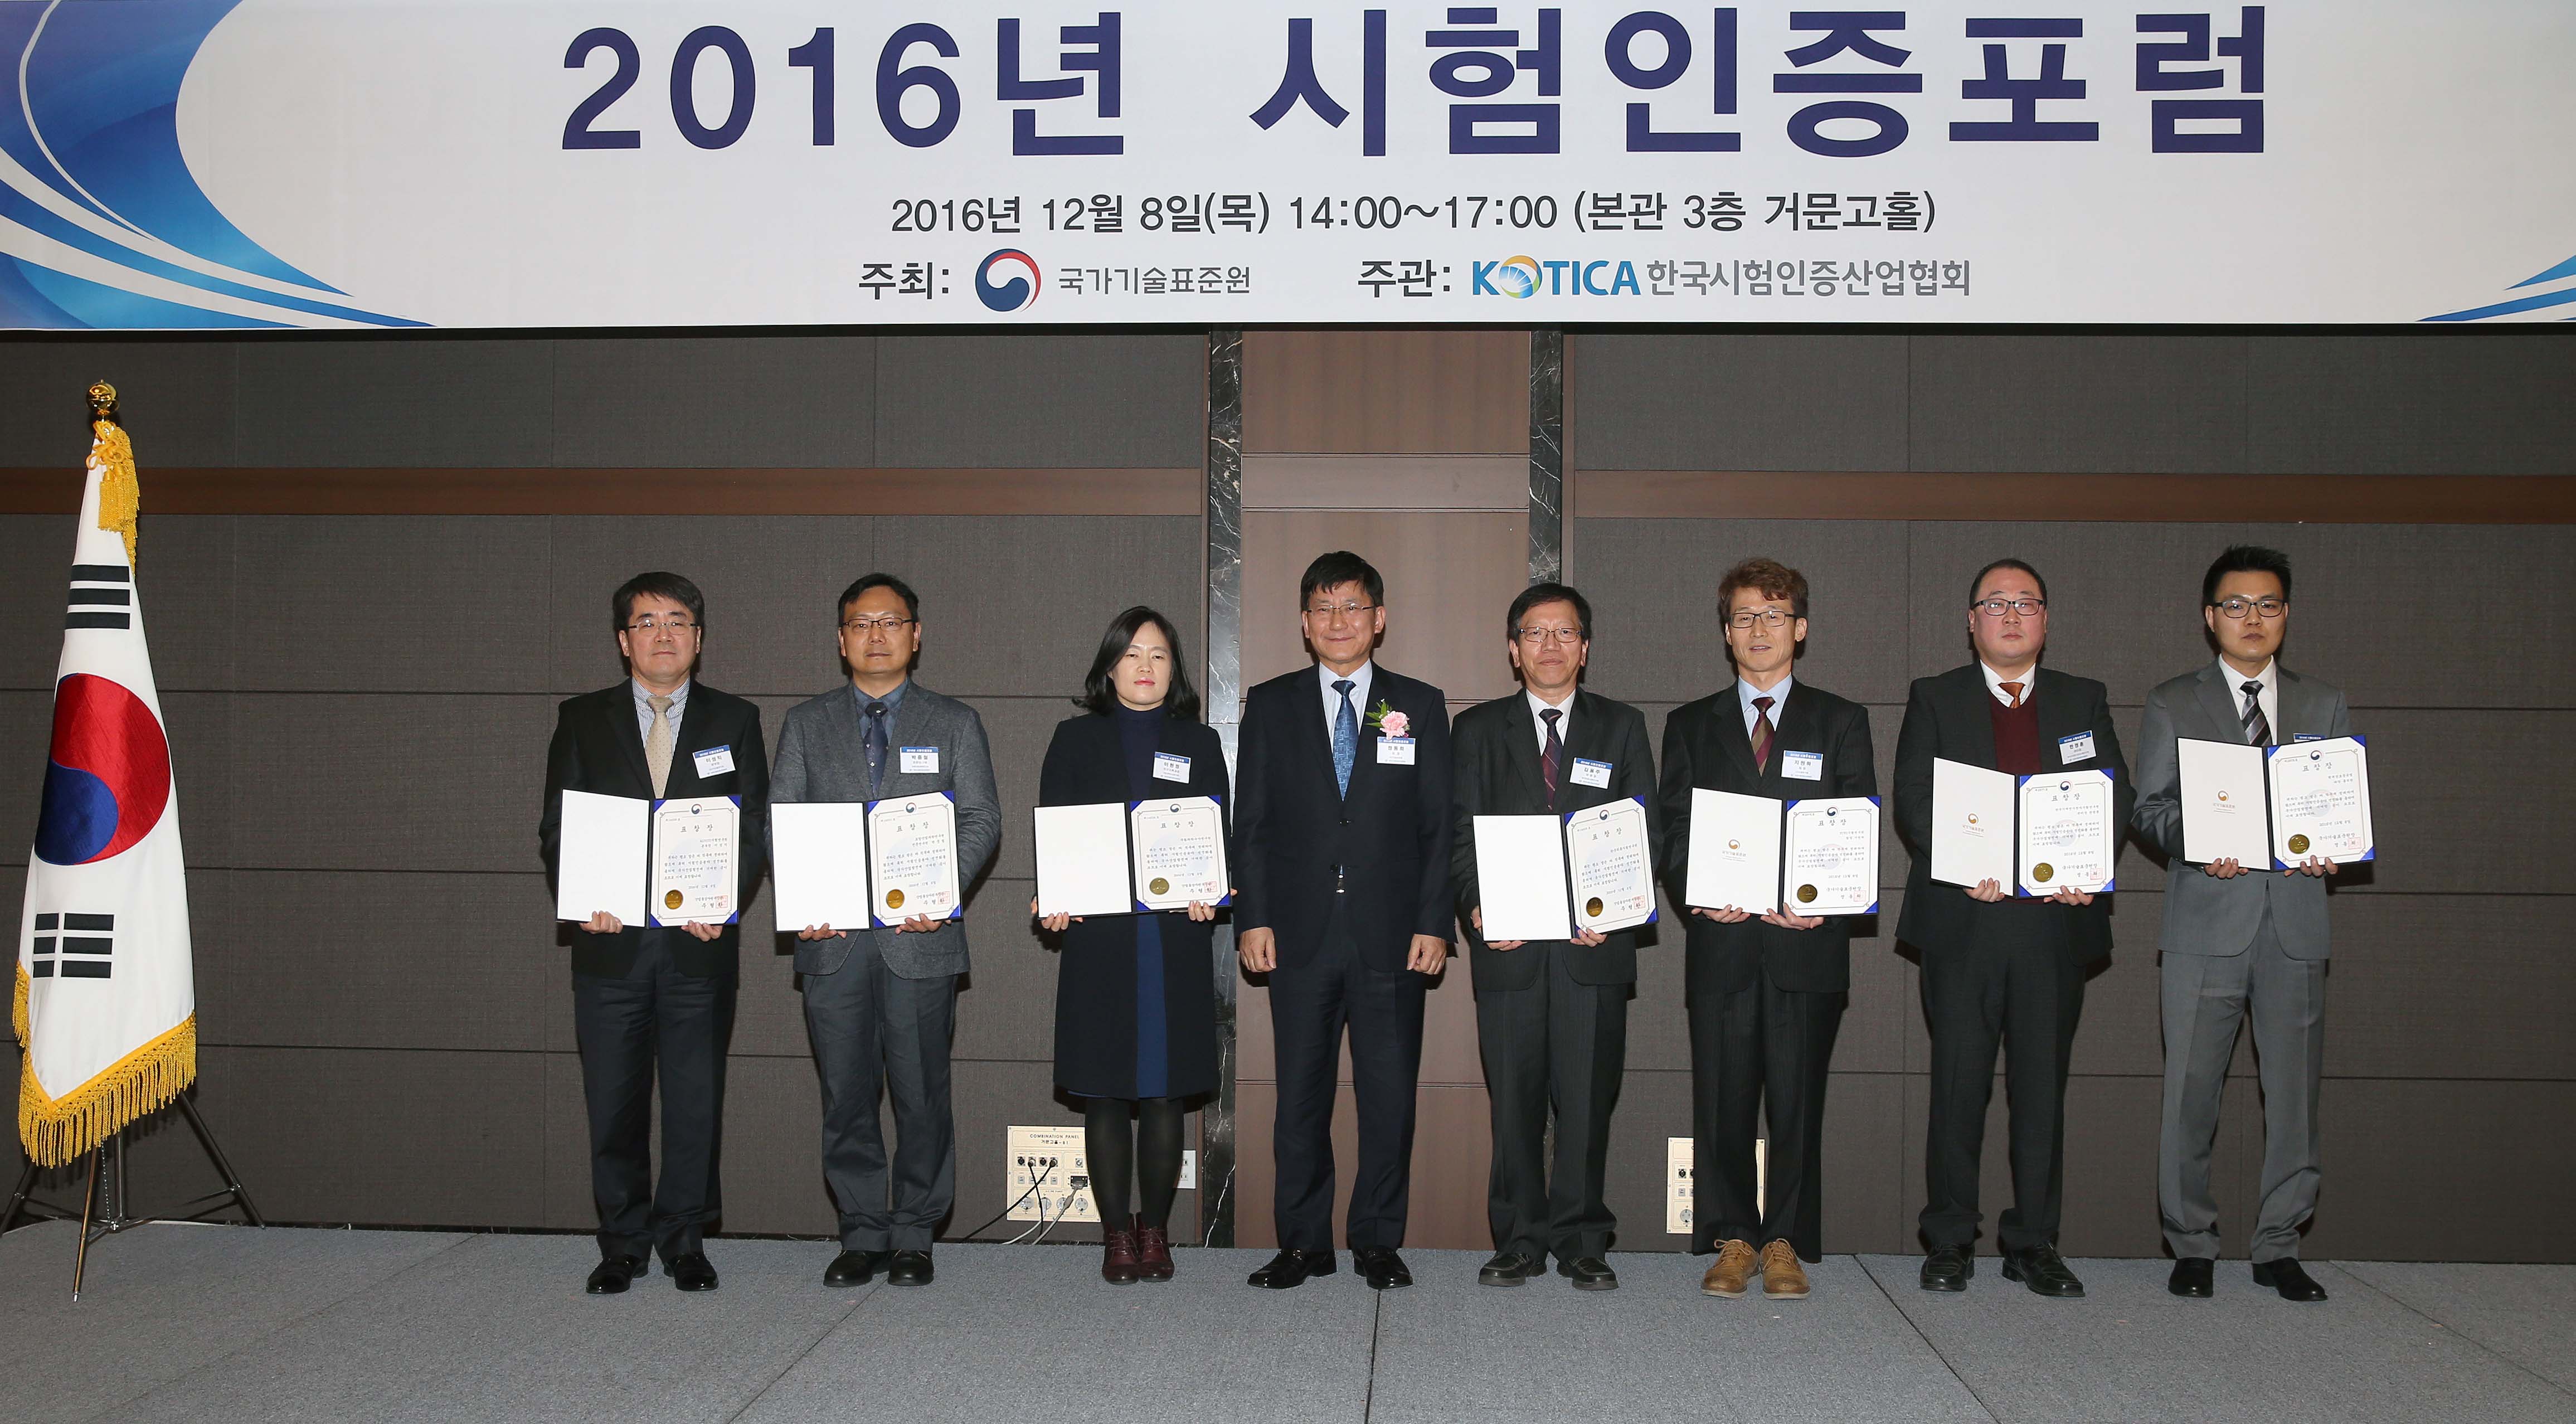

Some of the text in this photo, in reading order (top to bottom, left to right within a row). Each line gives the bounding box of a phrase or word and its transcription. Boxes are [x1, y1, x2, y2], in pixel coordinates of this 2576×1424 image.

[562, 6, 2265, 157] 2016년 시험인증포럼
[892, 196, 1020, 233] 2016년
[1043, 195, 1123, 232] 12월
[1141, 192, 1269, 234] 8일(목)
[1575, 191, 1668, 233] (본관
[1684, 192, 1746, 232] 3층
[1765, 191, 1935, 233] 거문고홀)
[859, 263, 1250, 299] 주최: 국가기술표준원
[1358, 255, 1970, 299] 주관: KOTICA 한국시험인증산업협회
